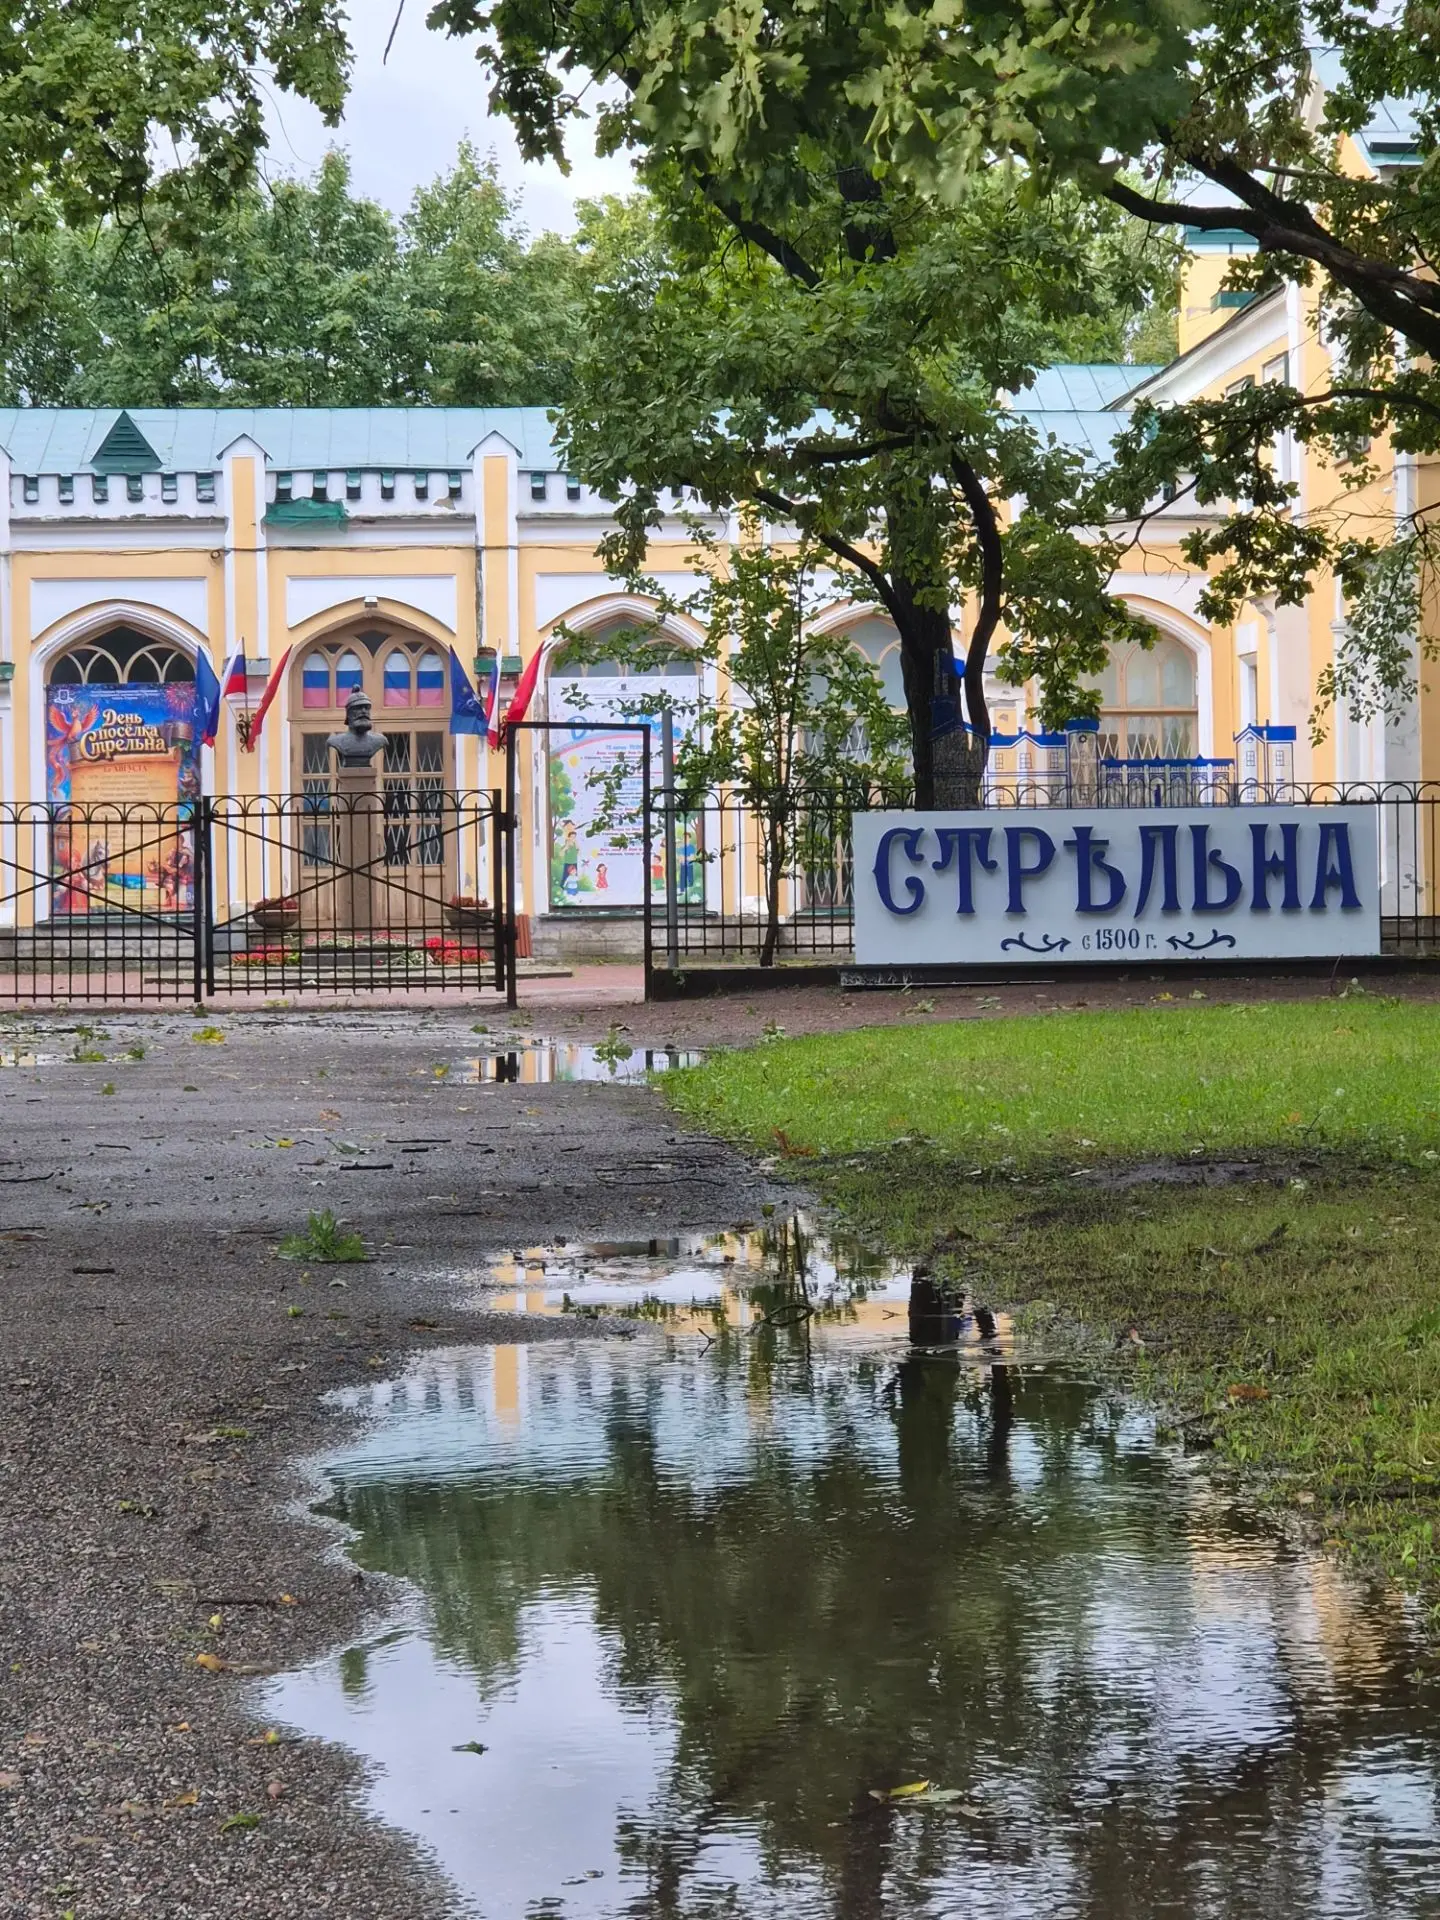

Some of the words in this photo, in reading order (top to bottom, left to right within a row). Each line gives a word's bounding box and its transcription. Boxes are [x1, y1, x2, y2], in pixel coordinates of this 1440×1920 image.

[102, 708, 142, 726] День
[98, 725, 158, 741] посёлка
[80, 731, 166, 760] Стрельна
[872, 822, 1363, 919] СТРѢЛЬНА
[1095, 928, 1140, 949] 1500
[1145, 934, 1157, 949] г.
